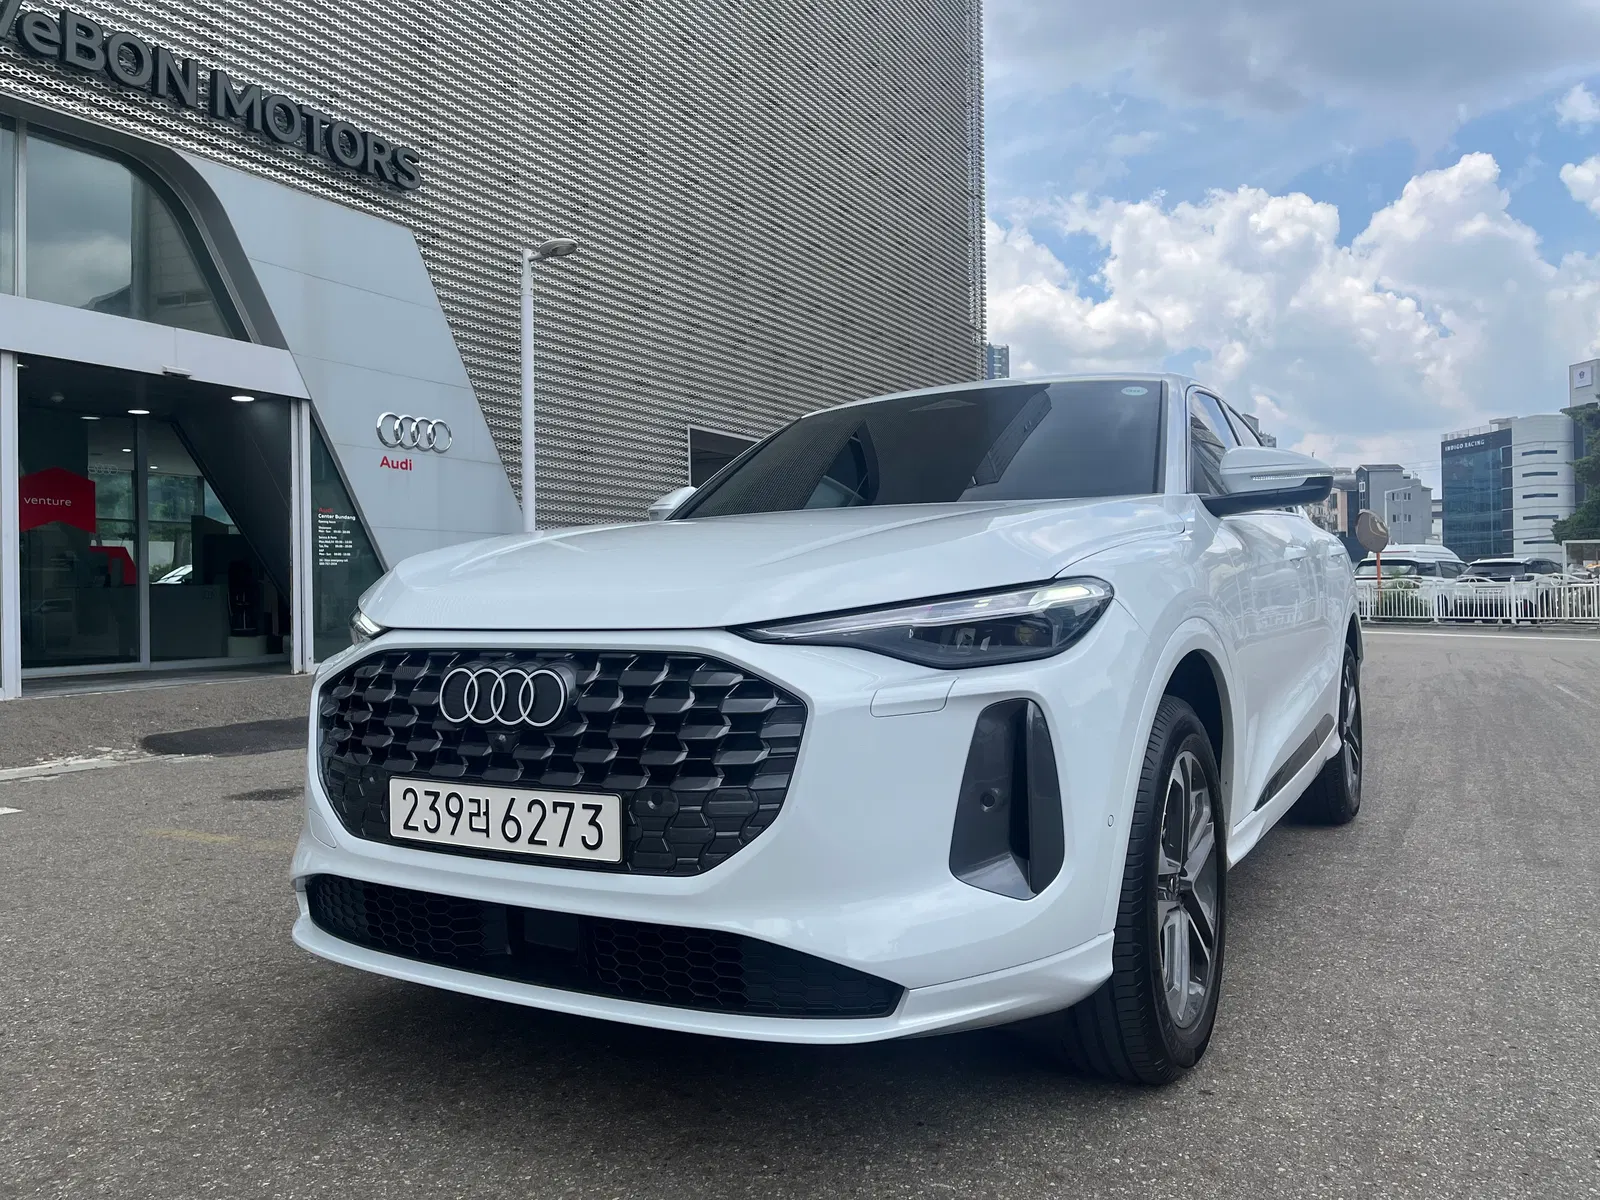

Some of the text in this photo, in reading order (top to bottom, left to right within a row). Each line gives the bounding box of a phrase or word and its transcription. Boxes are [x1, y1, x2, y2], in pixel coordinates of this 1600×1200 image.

[209, 69, 422, 190] MOTORS
[380, 456, 413, 471] Audi
[23, 497, 72, 507] venture
